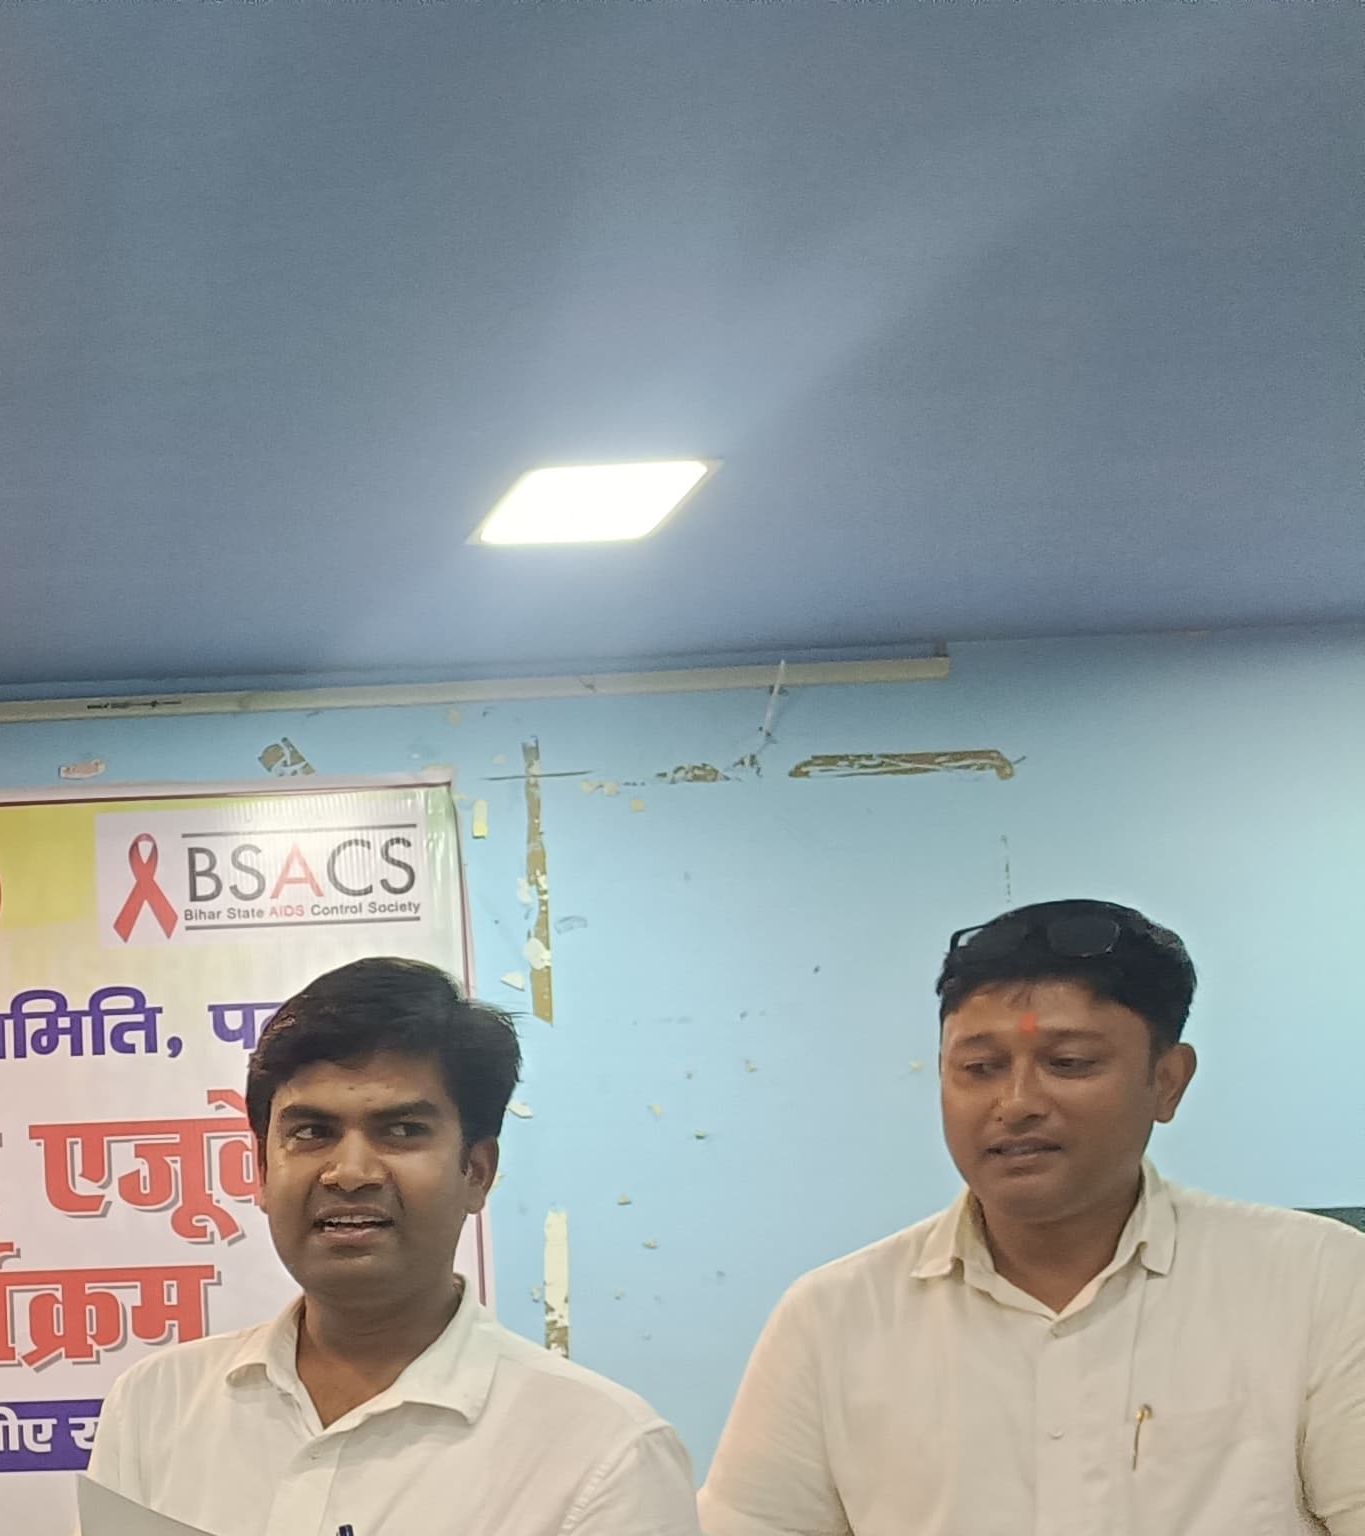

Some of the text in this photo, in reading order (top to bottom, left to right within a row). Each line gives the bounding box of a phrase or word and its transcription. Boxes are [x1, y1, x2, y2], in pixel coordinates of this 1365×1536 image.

[187, 836, 416, 902] BSACS
[184, 901, 421, 921] Bihar State AIDS Control Society
